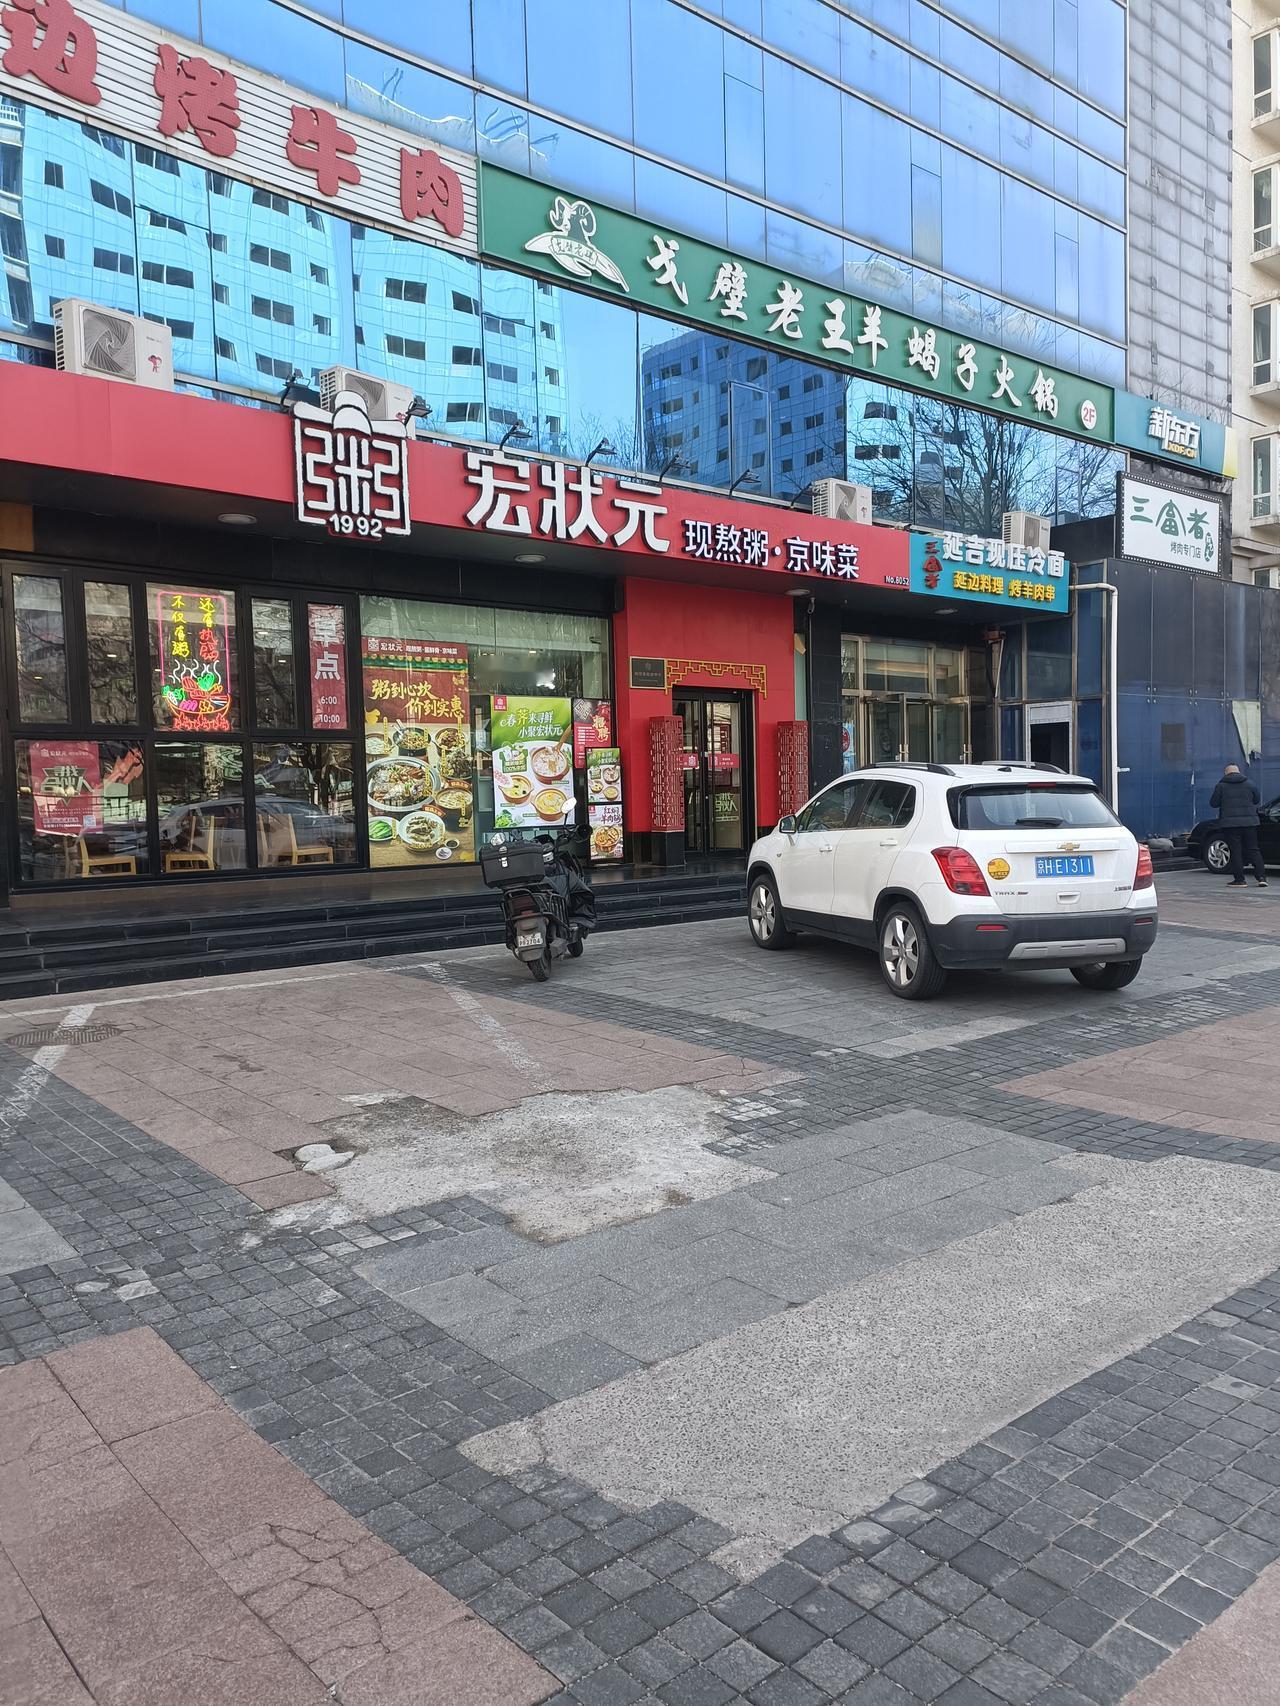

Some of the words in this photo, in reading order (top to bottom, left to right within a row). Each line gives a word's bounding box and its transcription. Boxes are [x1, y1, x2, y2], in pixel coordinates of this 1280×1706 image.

[0, 0, 464, 238] 边烤牛肉
[1083, 406, 1096, 424] 2F
[1148, 406, 1201, 450] 新东方
[329, 513, 383, 538] 1992
[942, 531, 1065, 577] 延吉现压冷面
[953, 571, 1004, 595] 延边料理
[1008, 579, 1056, 602] 烤羊肉串
[171, 595, 189, 657] 不仅有粥
[313, 618, 341, 680] 早点
[320, 696, 338, 704] 6:00
[368, 679, 440, 700] 粥到心坎
[319, 714, 340, 723] 10:00
[401, 696, 466, 721] 价到实惠
